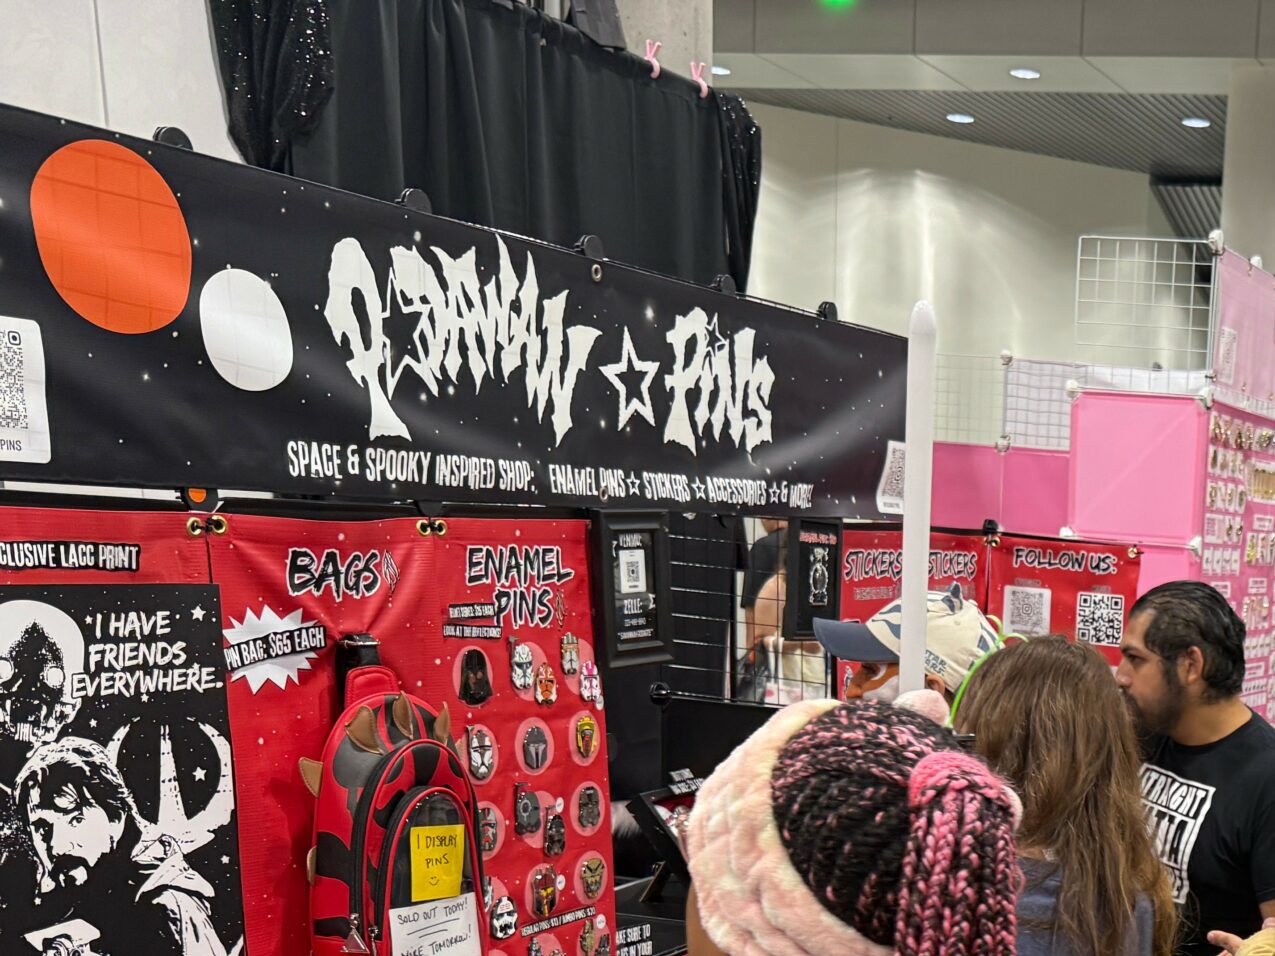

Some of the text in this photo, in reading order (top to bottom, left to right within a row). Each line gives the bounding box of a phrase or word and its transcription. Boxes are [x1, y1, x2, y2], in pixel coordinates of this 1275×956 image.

[287, 440, 813, 509] SPACE & SPOOKY INSPIRED SHOP: ENAMEL PINS STICKERS ACCESSORIES & MORE!
[60, 543, 95, 568] LACC
[98, 544, 139, 571] PRINT
[466, 544, 575, 588] ENAMEL
[844, 548, 902, 581] STICKERS
[1013, 547, 1118, 575] FOLLOW US:
[285, 547, 382, 603] BAGS
[494, 586, 554, 630] PINS
[95, 610, 172, 640] I HAVE
[88, 641, 187, 673] FRIENDS
[224, 626, 325, 671] PIN BAG: $65 EACH
[72, 667, 224, 698] EVERYWHERE.
[925, 658, 947, 677] ARS
[416, 833, 458, 850] I DISPLAY
[425, 852, 450, 869] PINS
[397, 897, 468, 926] SOLD OUT TODAY!
[430, 924, 472, 956] TOMORROW!
[616, 924, 651, 945] AKE SURE TO
[637, 940, 653, 956] YOUR
